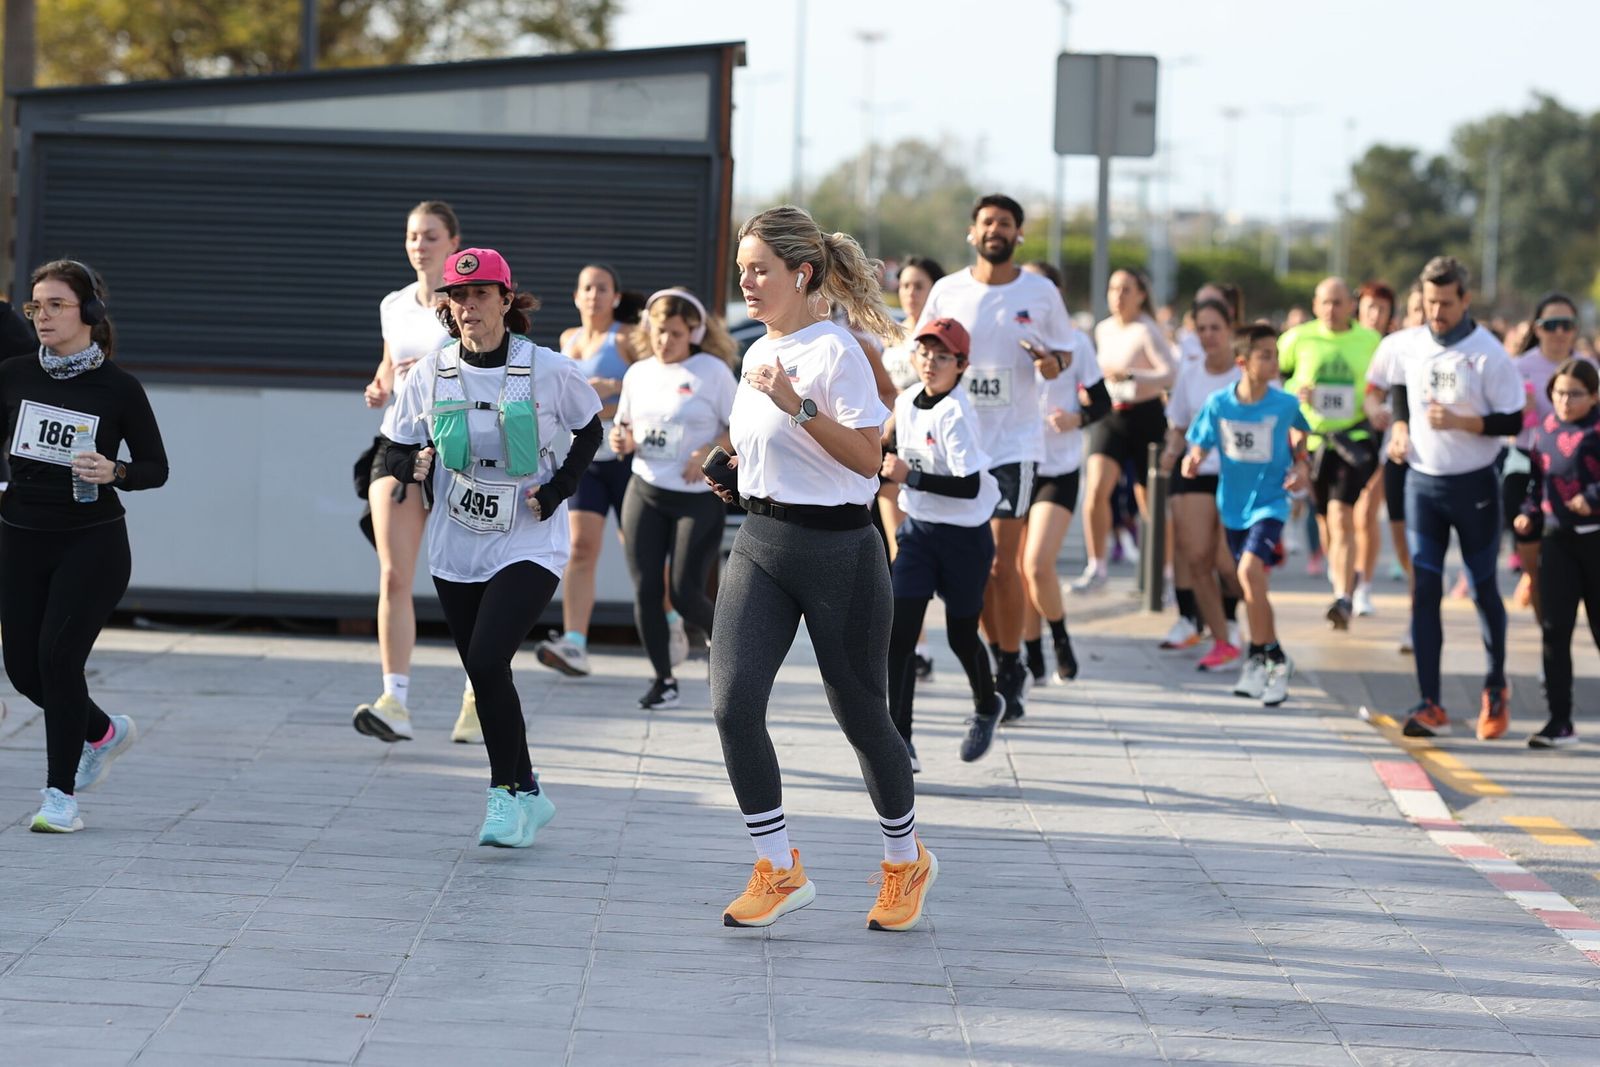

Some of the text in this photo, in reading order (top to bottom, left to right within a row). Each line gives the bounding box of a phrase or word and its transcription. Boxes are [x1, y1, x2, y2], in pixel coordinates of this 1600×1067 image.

[969, 378, 1000, 396] 443
[38, 419, 77, 448] 186
[1234, 431, 1254, 449] 36
[460, 488, 499, 519] 495
